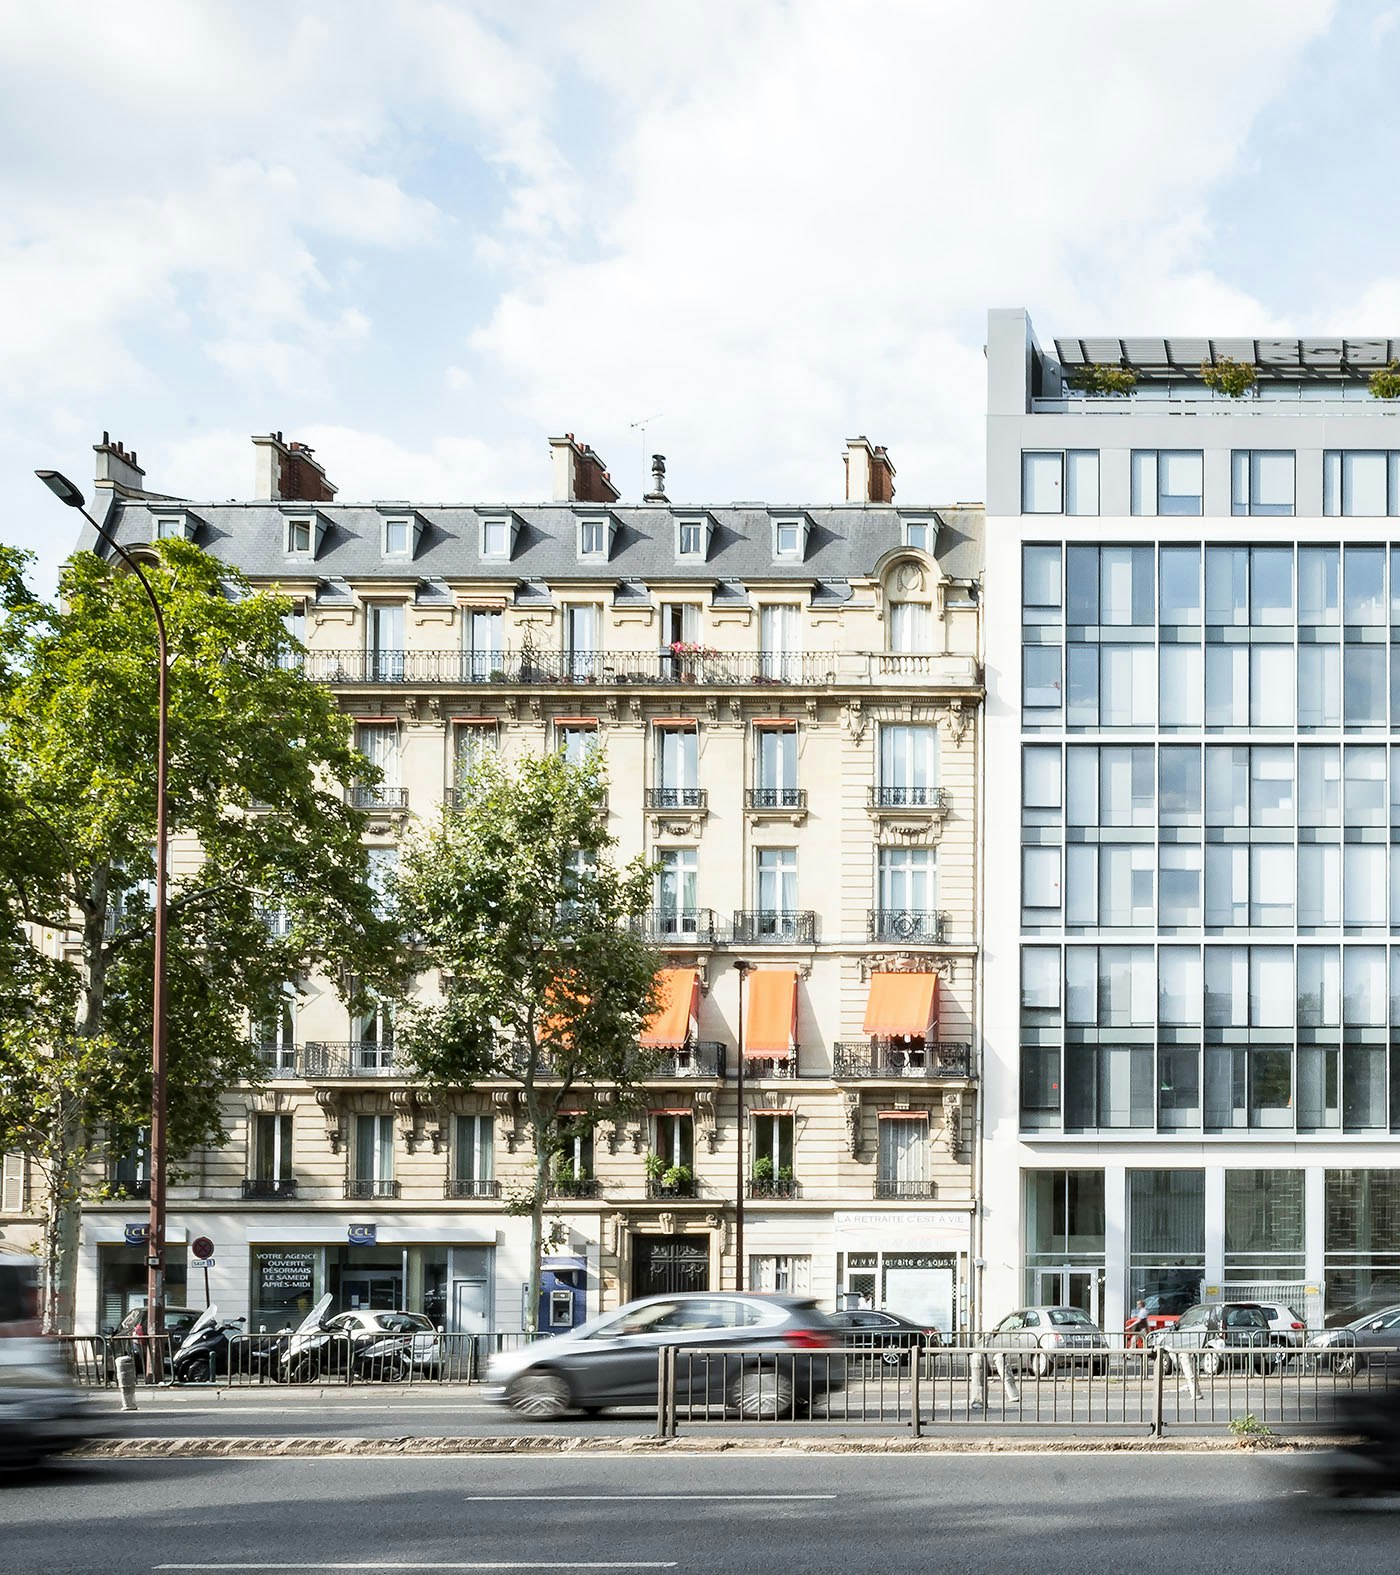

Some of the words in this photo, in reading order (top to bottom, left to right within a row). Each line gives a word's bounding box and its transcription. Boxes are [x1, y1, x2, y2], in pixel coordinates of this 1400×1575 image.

[854, 1215, 904, 1224] RETRAITE
[906, 1214, 936, 1224] C'EST
[948, 1215, 965, 1224] VIE
[125, 1228, 148, 1236] LCL
[349, 1227, 371, 1236] LCL
[262, 1266, 312, 1274] DÉSORMAIS
